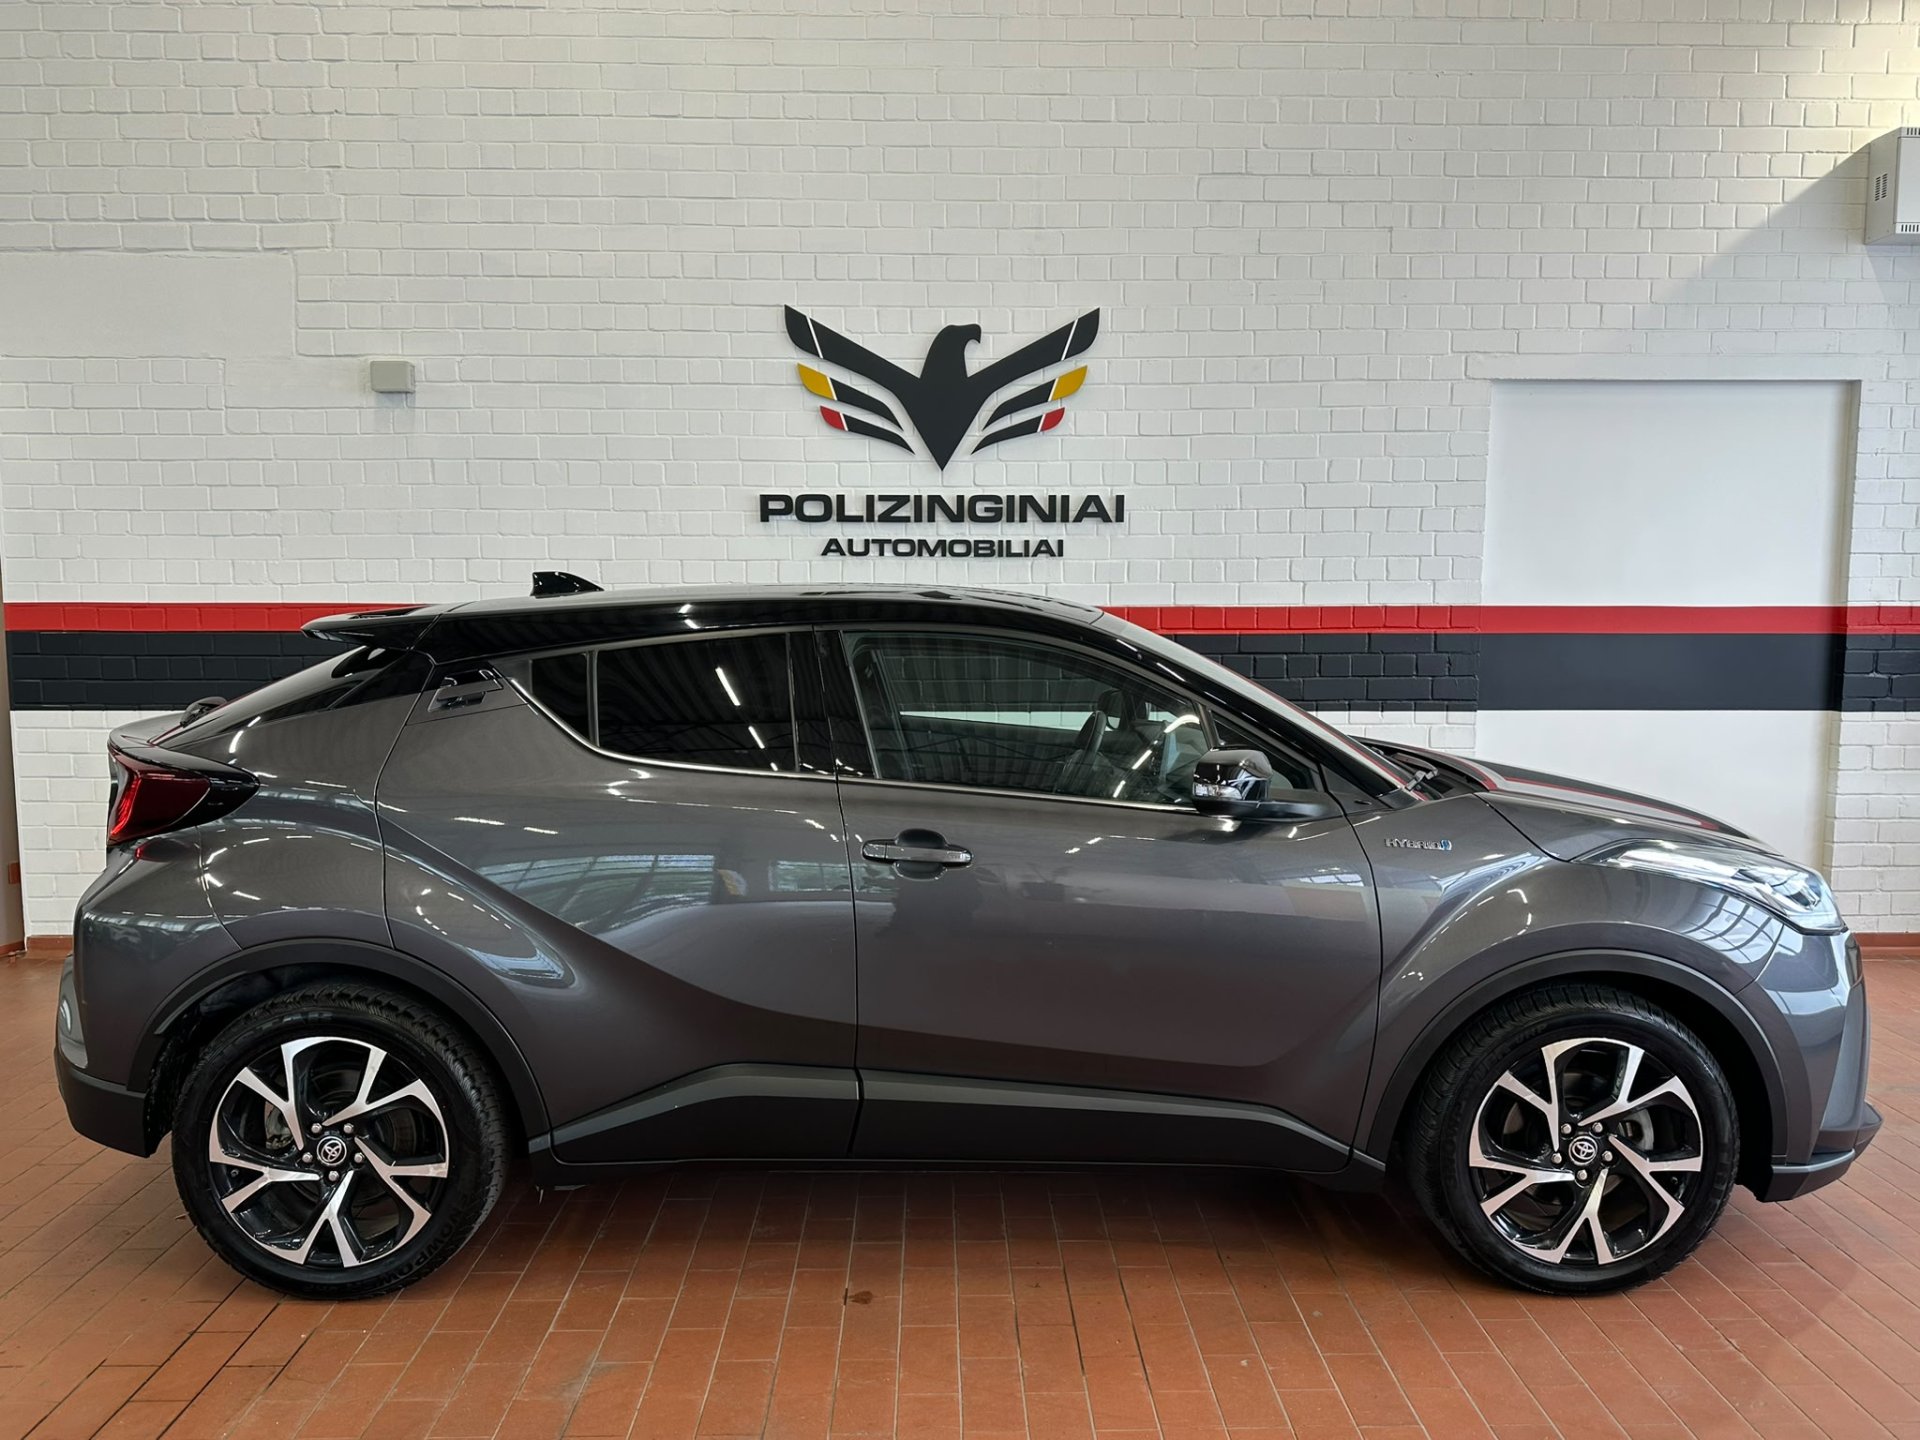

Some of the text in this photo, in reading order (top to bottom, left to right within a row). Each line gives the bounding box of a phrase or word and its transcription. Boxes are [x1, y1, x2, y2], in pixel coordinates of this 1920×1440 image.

[760, 494, 1124, 523] POLIZINGINIAI
[821, 539, 1063, 557] AUTOMOBILIAI
[1385, 838, 1441, 850] HYBRID
